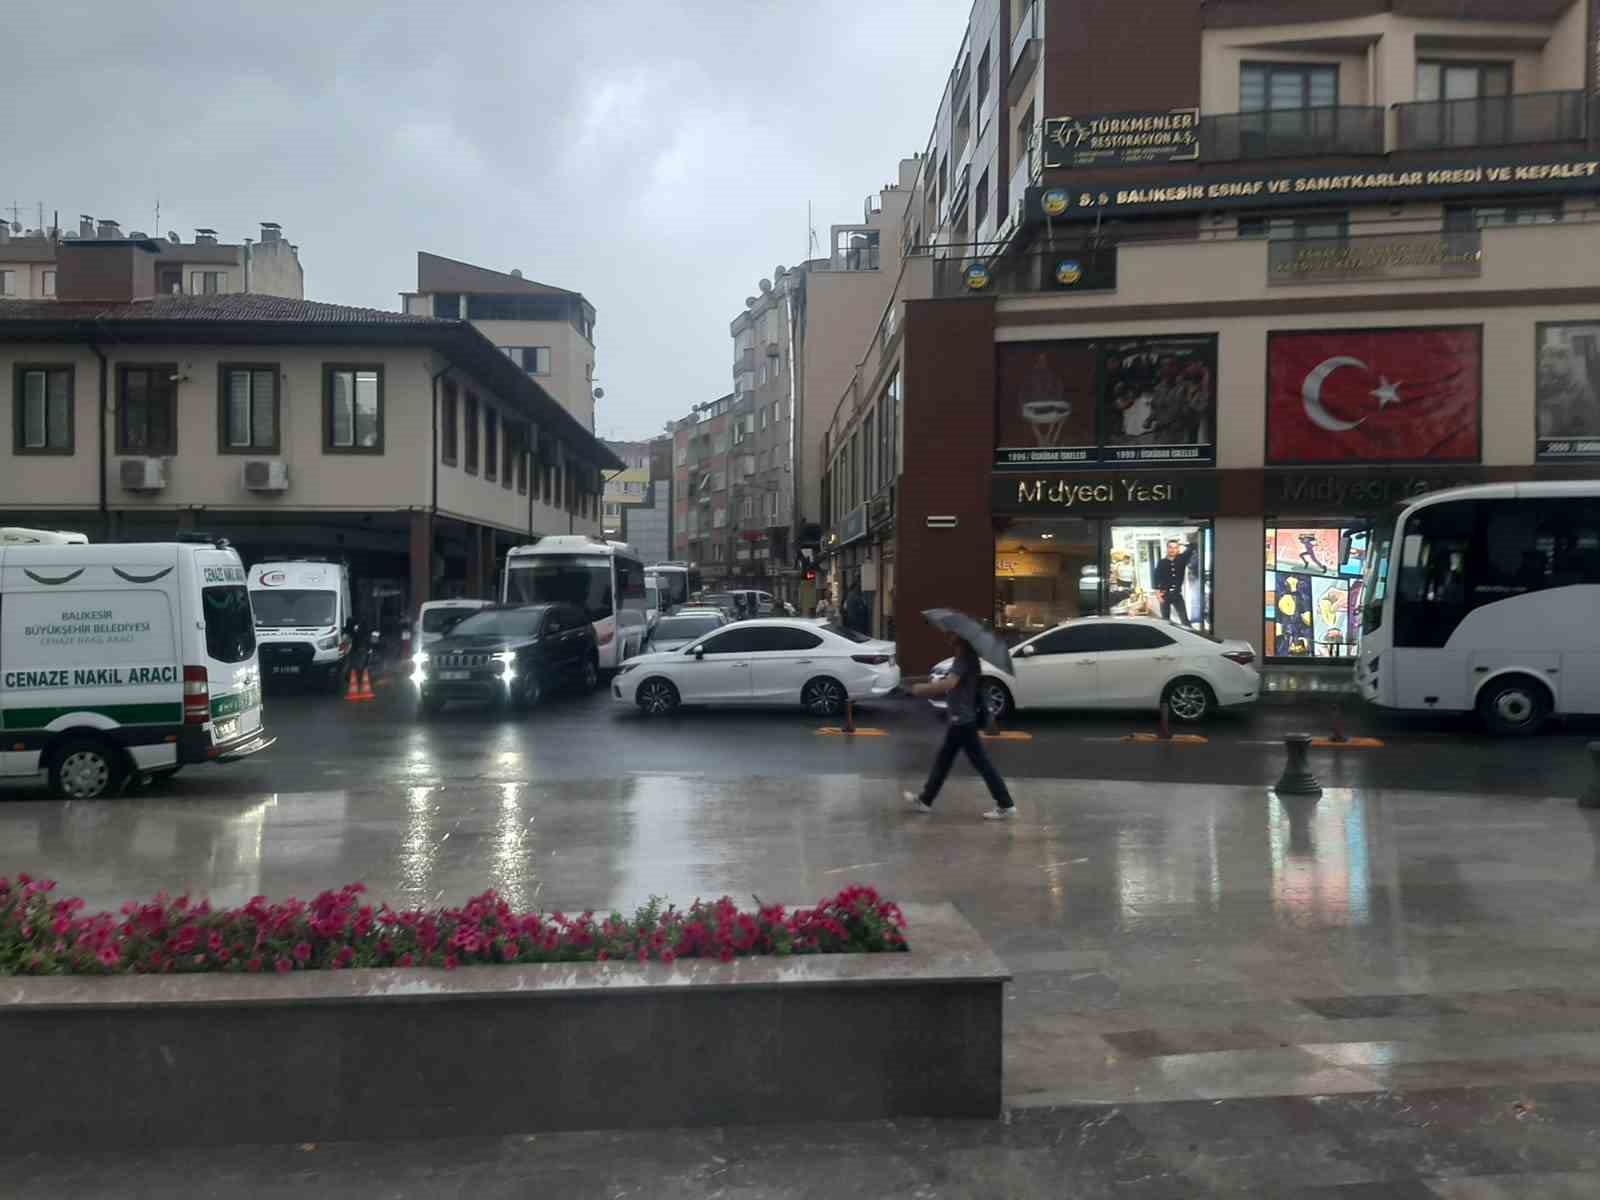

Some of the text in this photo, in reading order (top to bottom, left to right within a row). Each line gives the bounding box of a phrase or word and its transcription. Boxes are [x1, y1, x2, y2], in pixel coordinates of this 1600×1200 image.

[1089, 114, 1192, 134] TÜRKMENLER
[1117, 184, 1204, 205] BALIKESİR
[1208, 181, 1264, 198] ESNAF
[1267, 179, 1291, 193] VE
[1295, 171, 1423, 192] SANATKARLAR
[1427, 166, 1483, 185] KREDİ
[1486, 166, 1512, 181] VE
[1515, 161, 1599, 180] KEFALET
[61, 609, 113, 621] BALIKESİR
[5, 670, 69, 688] CENAZE
[128, 666, 177, 683] ARACI
